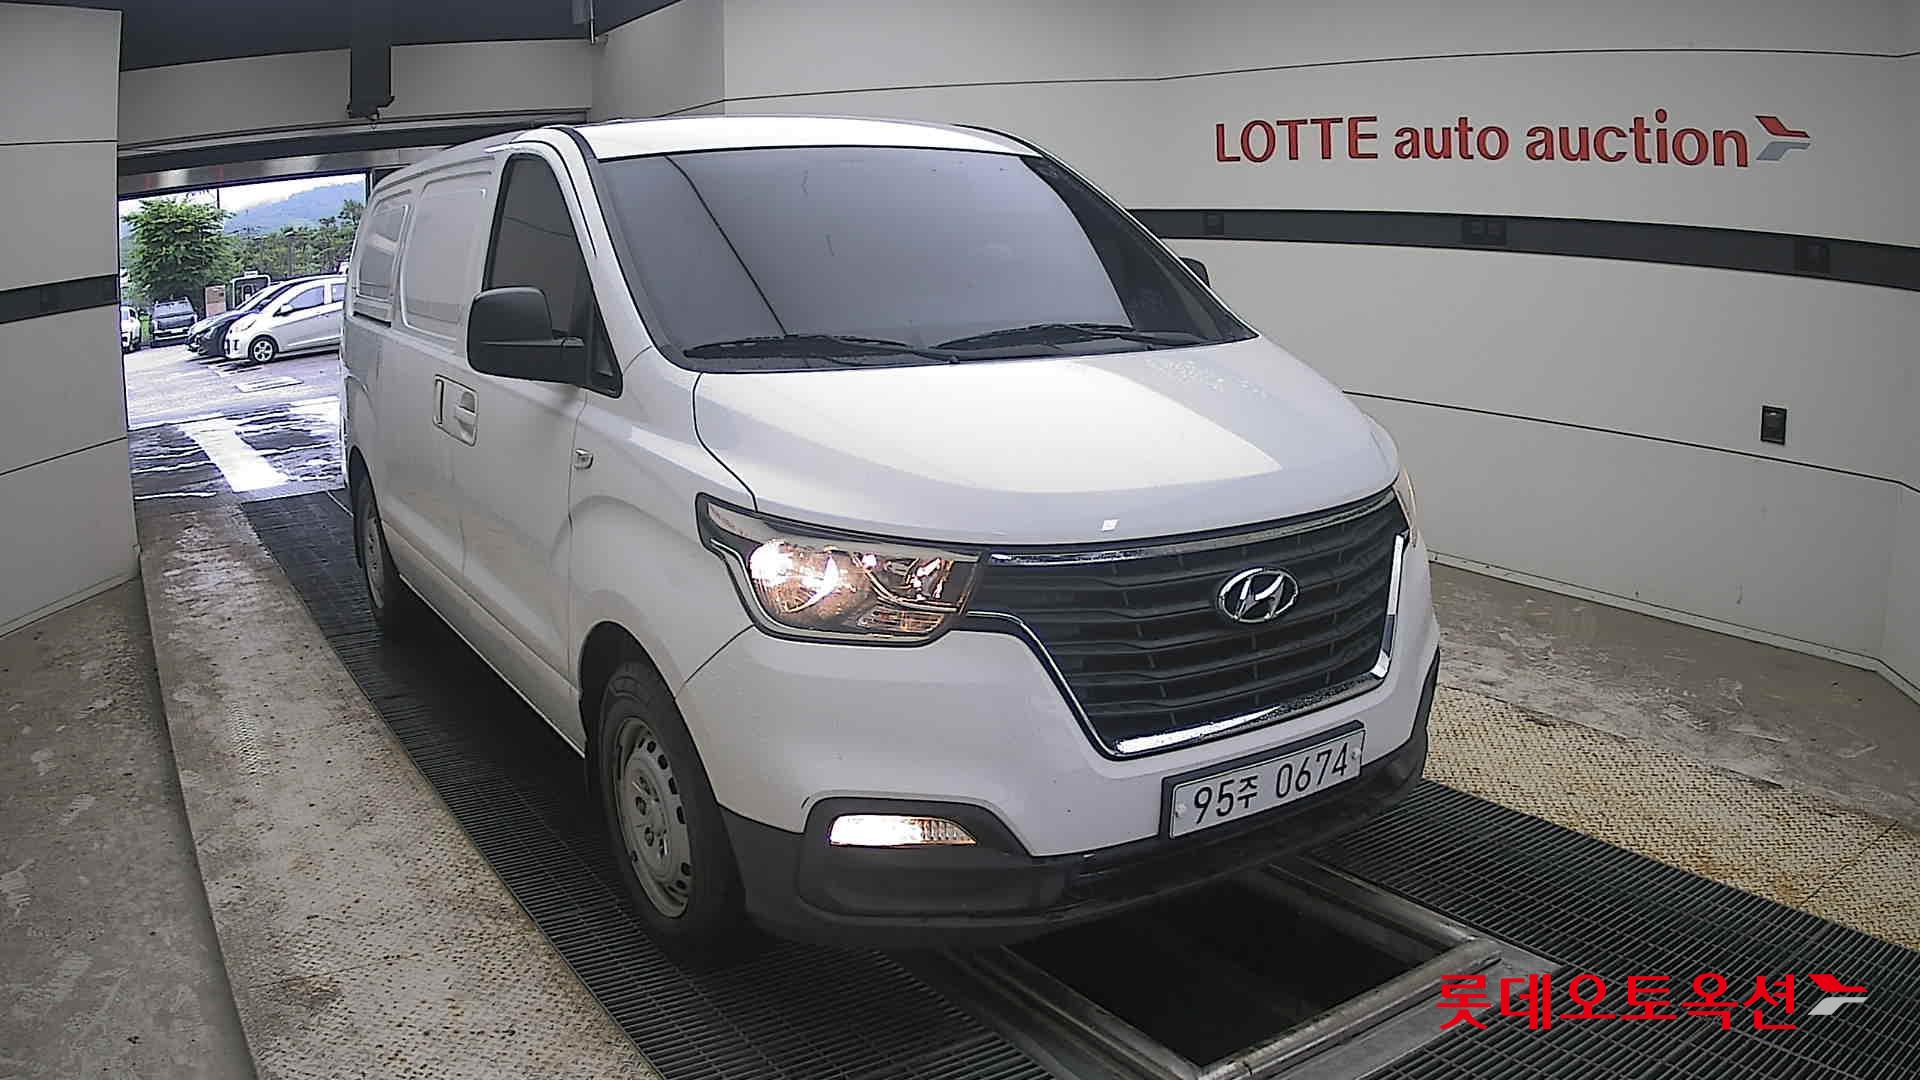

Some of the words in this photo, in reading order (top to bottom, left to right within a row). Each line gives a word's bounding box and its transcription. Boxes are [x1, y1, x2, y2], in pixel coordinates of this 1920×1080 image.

[1215, 116, 1379, 162] LOTTE
[1393, 116, 1510, 161] auto
[1525, 108, 1749, 168] auction
[1193, 776, 1258, 825] 95주
[1275, 742, 1349, 799] 0674
